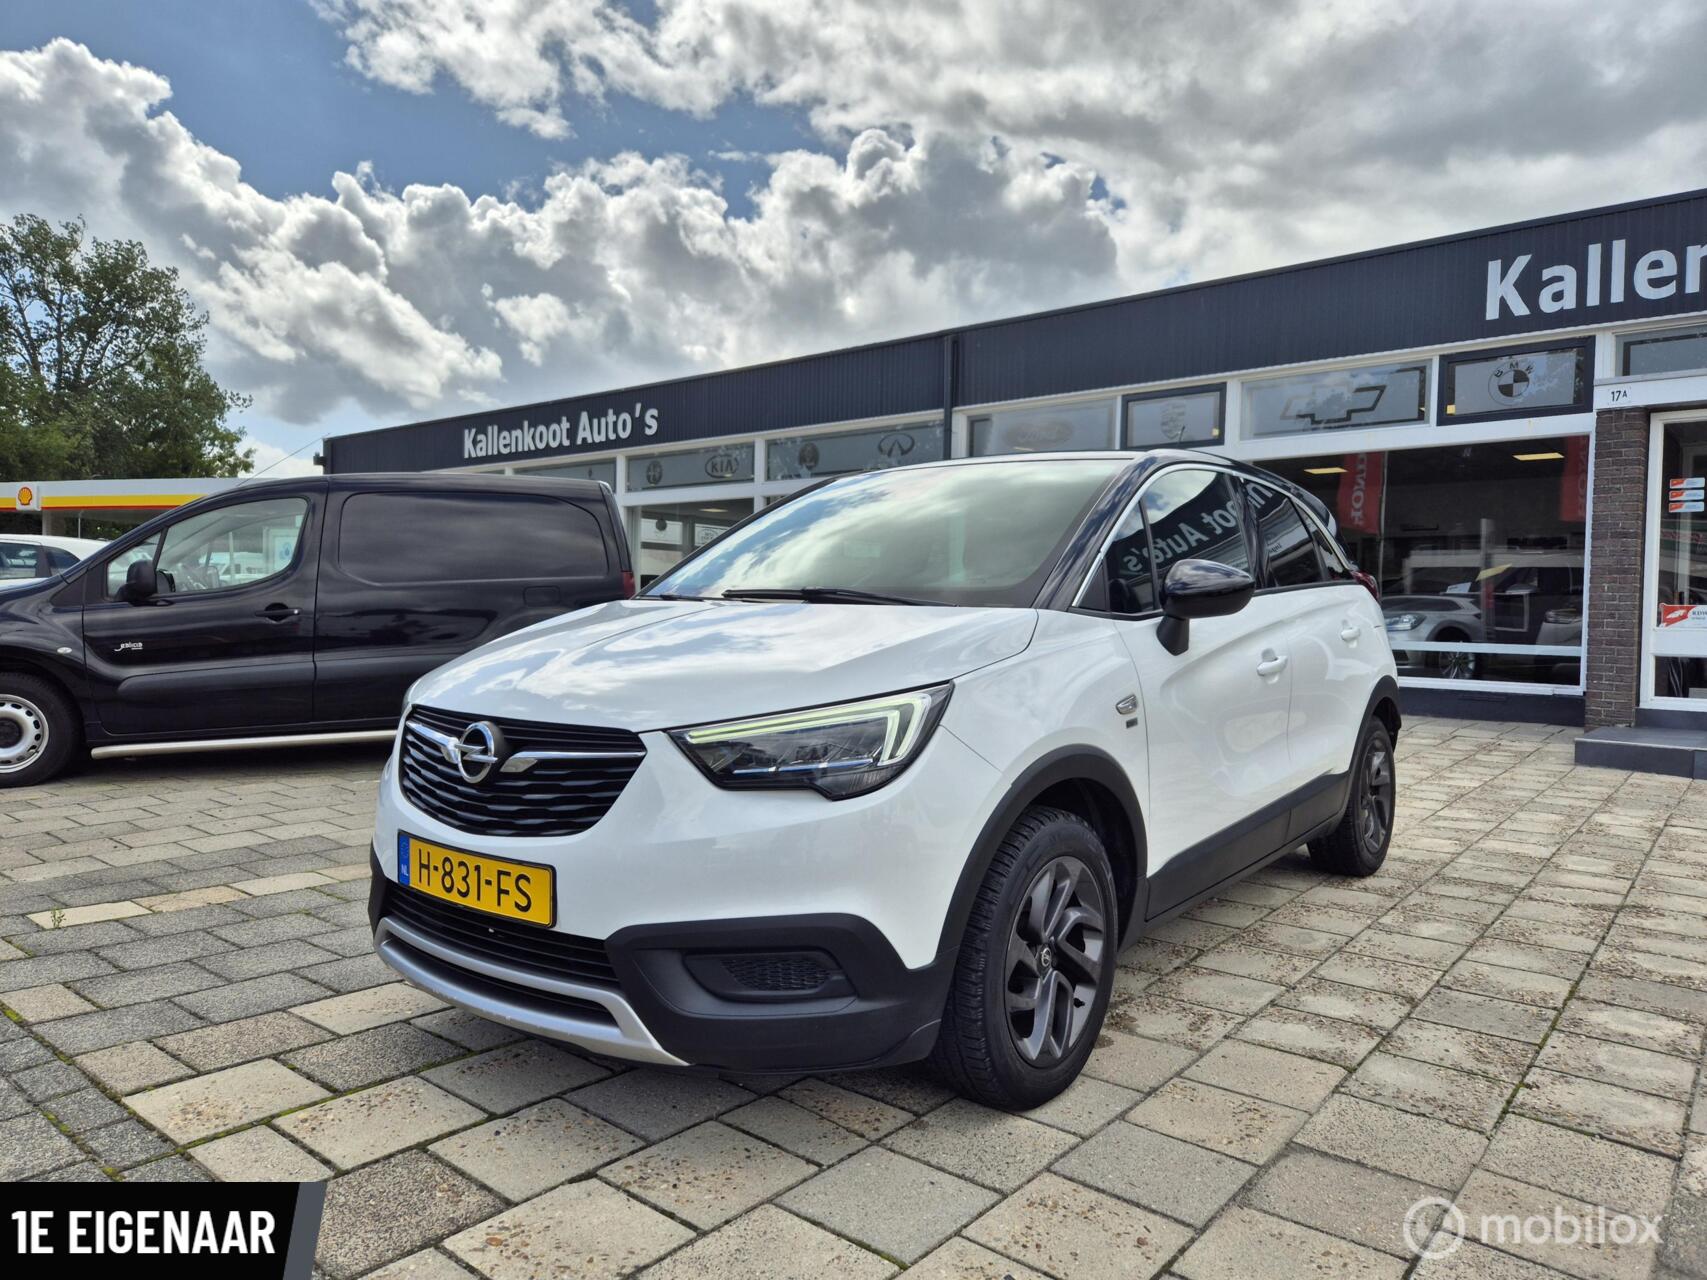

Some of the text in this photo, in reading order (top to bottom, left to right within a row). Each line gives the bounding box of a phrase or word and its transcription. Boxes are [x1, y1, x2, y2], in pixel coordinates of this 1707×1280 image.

[463, 402, 660, 459] Kallenkoot Auto's
[711, 459, 734, 473] KIA
[401, 864, 409, 876] NL
[418, 848, 532, 913] H-831-FS
